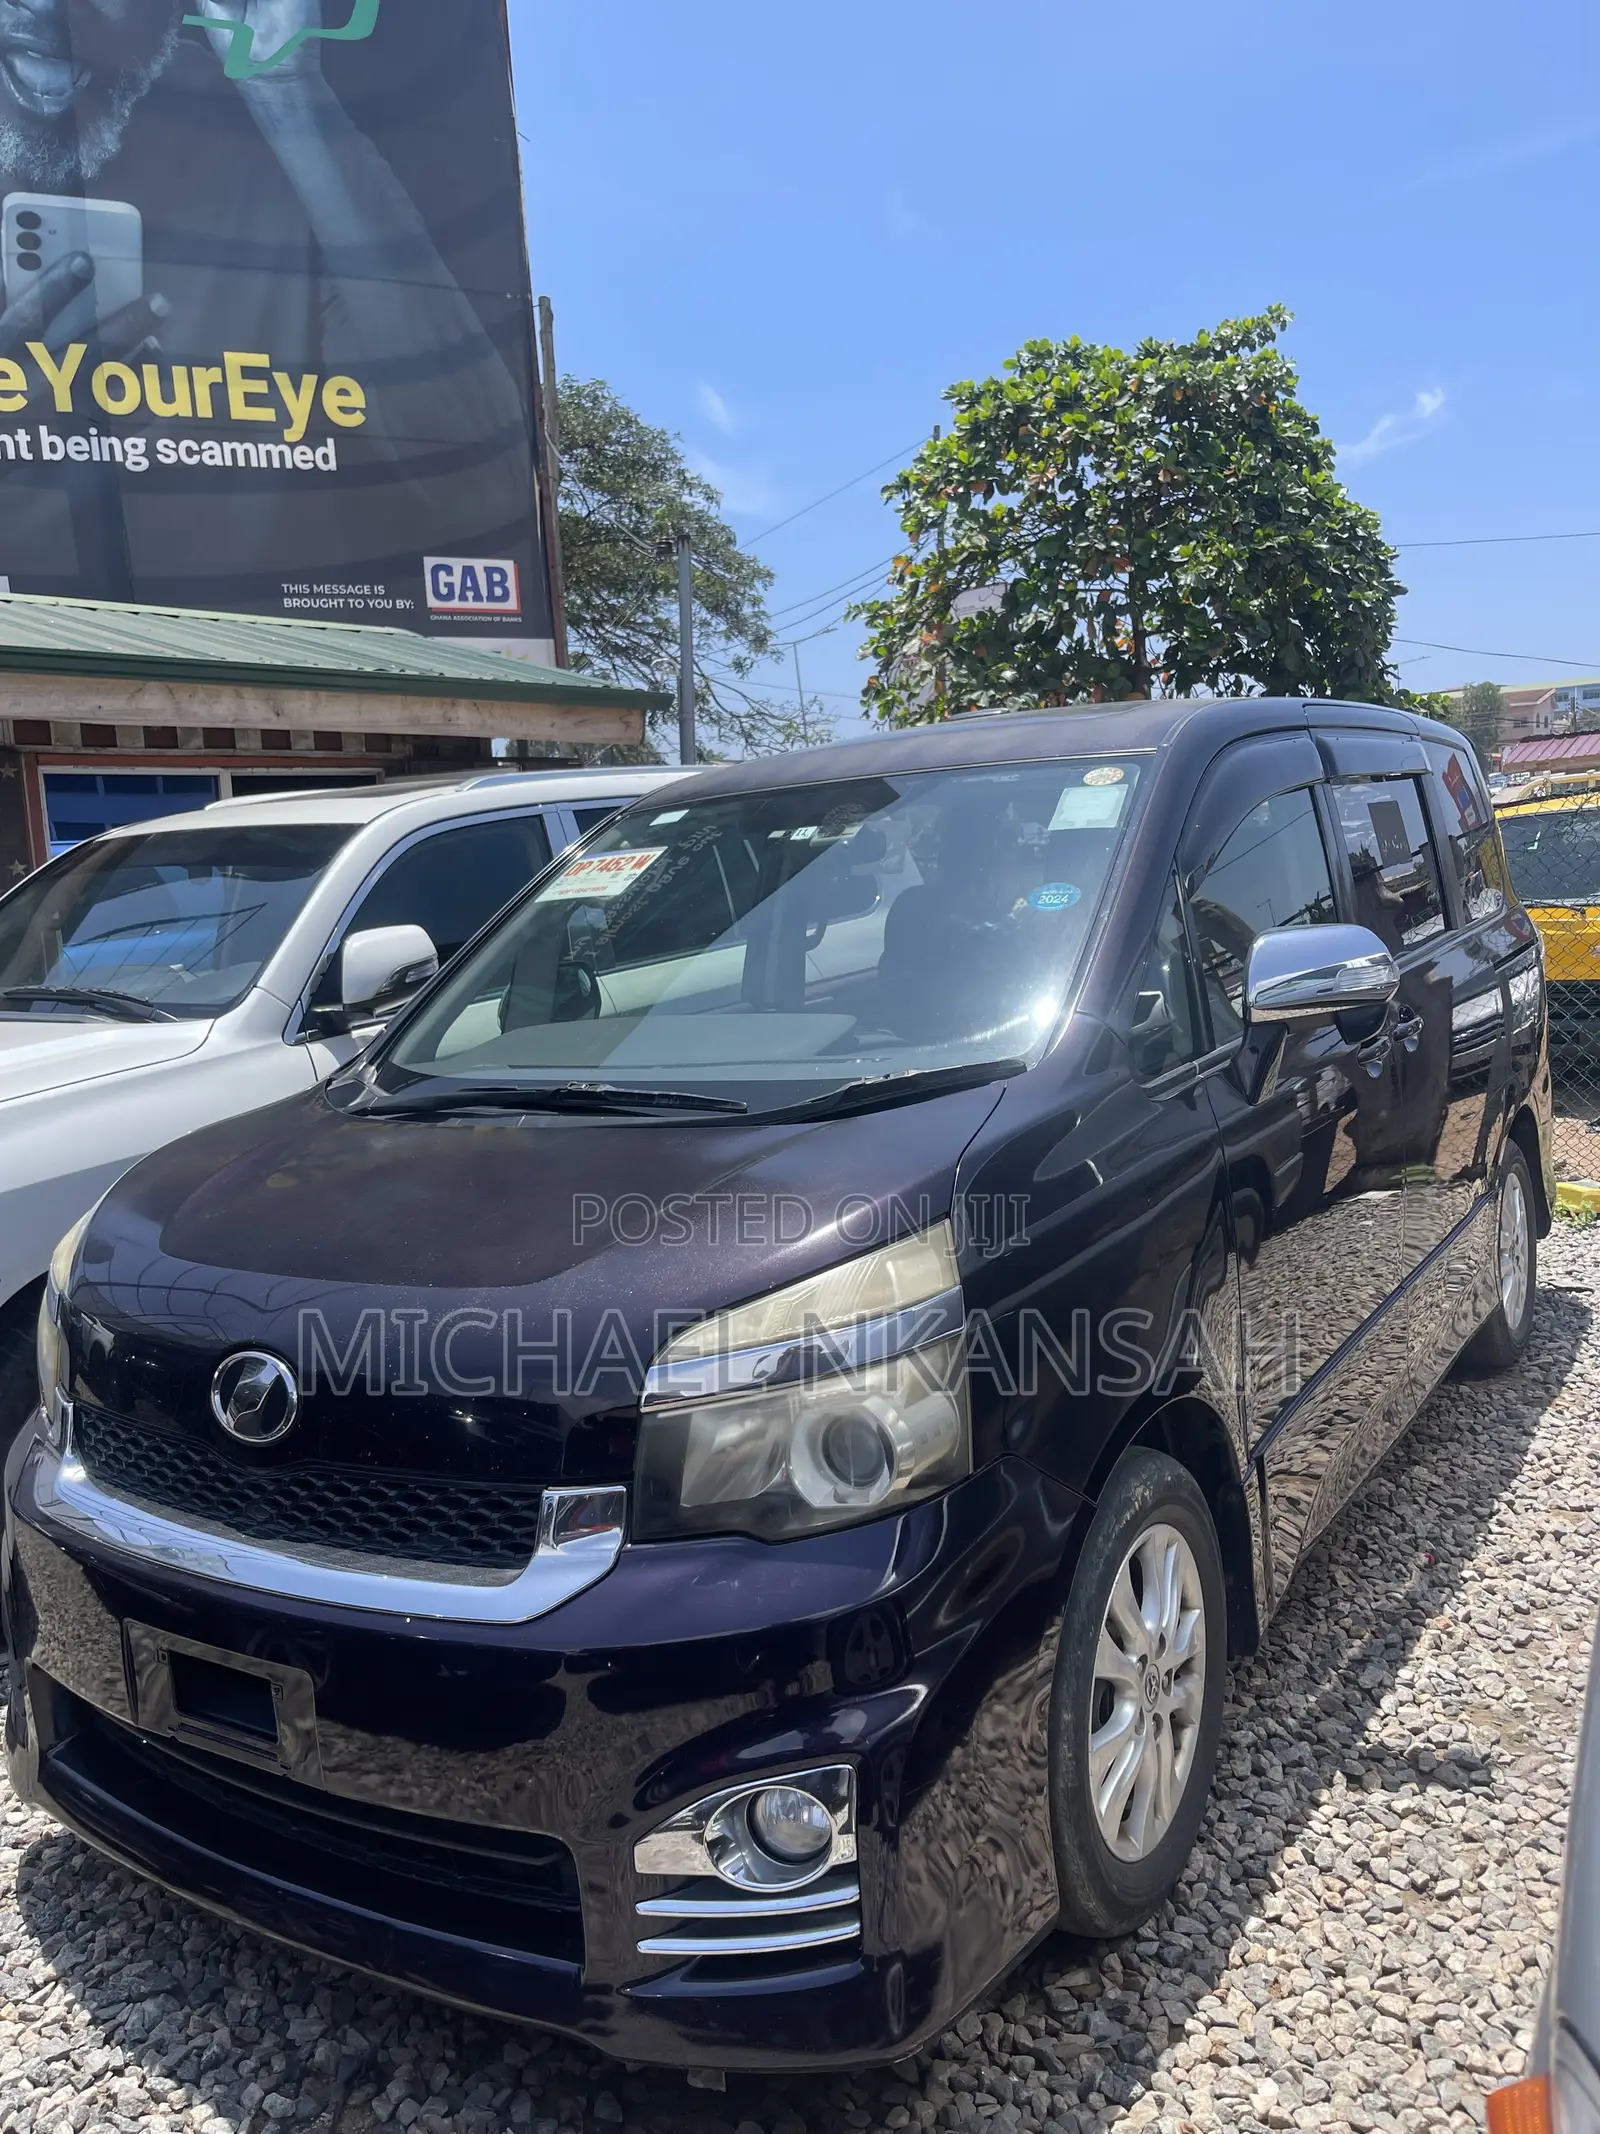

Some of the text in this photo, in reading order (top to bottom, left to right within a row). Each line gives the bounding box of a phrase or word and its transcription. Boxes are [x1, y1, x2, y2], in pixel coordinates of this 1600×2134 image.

[39, 425, 150, 473] being
[156, 437, 338, 472] scammed
[281, 583, 386, 596] THIS MESSAGE IS
[430, 563, 512, 604] GAB
[283, 598, 415, 610] BROUGHT TO YOU BY:
[587, 854, 637, 875] 7452
[630, 853, 656, 871] W
[1037, 894, 1069, 905] 2024
